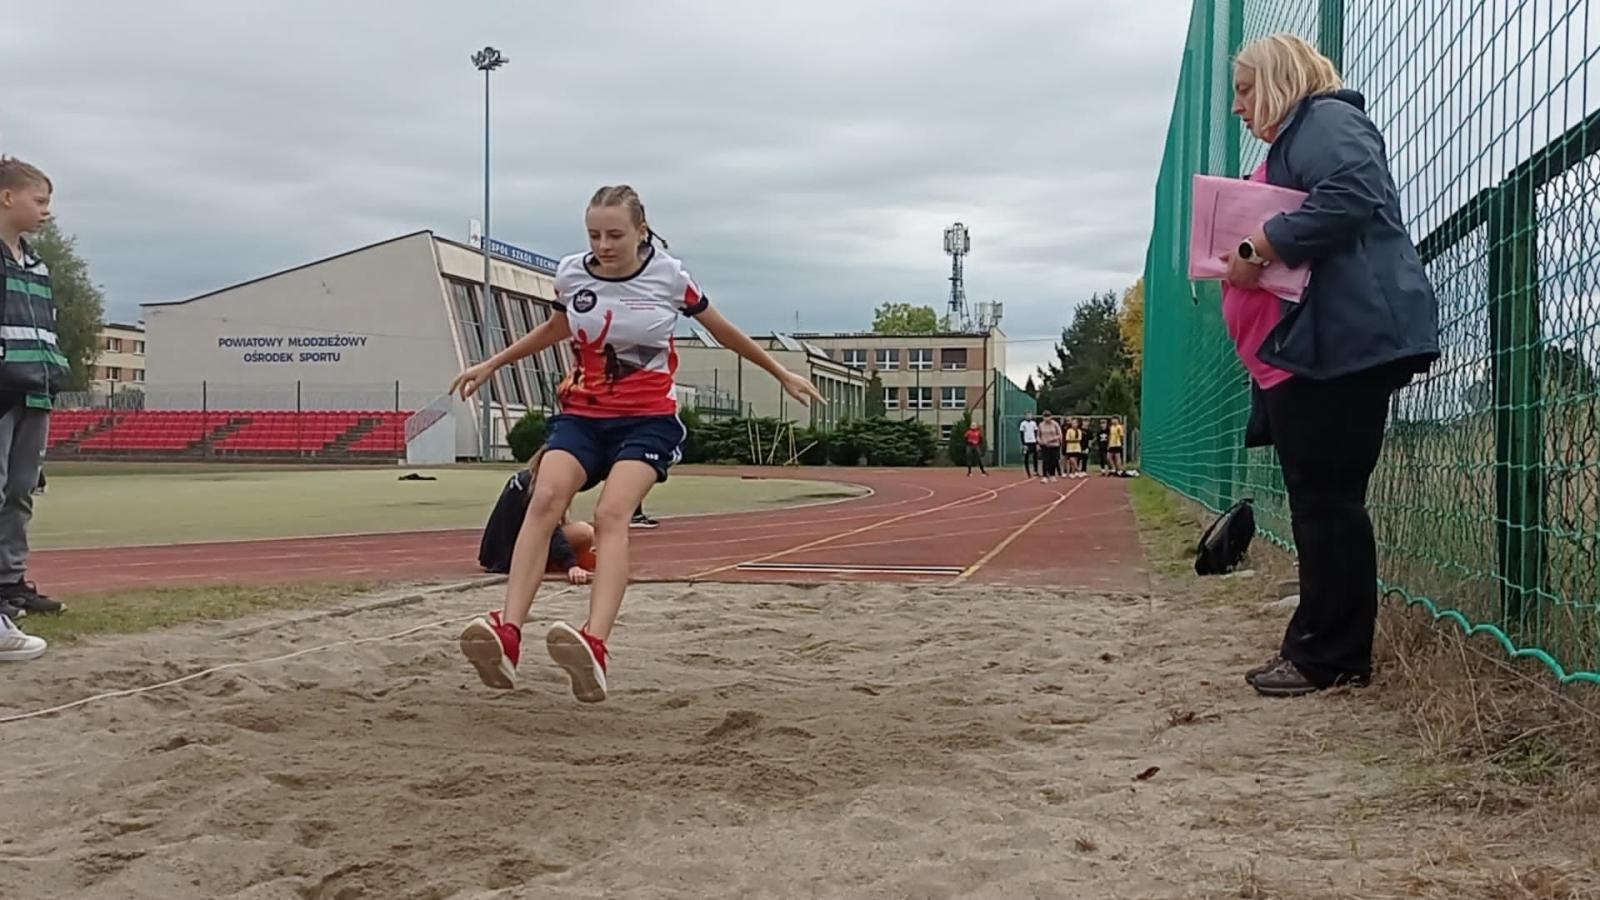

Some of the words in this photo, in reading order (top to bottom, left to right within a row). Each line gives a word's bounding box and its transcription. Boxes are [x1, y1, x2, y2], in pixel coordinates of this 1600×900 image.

[218, 338, 283, 348] POWIATOWY
[288, 334, 367, 347] MŁODZIEŻOWY
[244, 350, 293, 362] OŚRODEK
[299, 352, 341, 362] SPORTU
